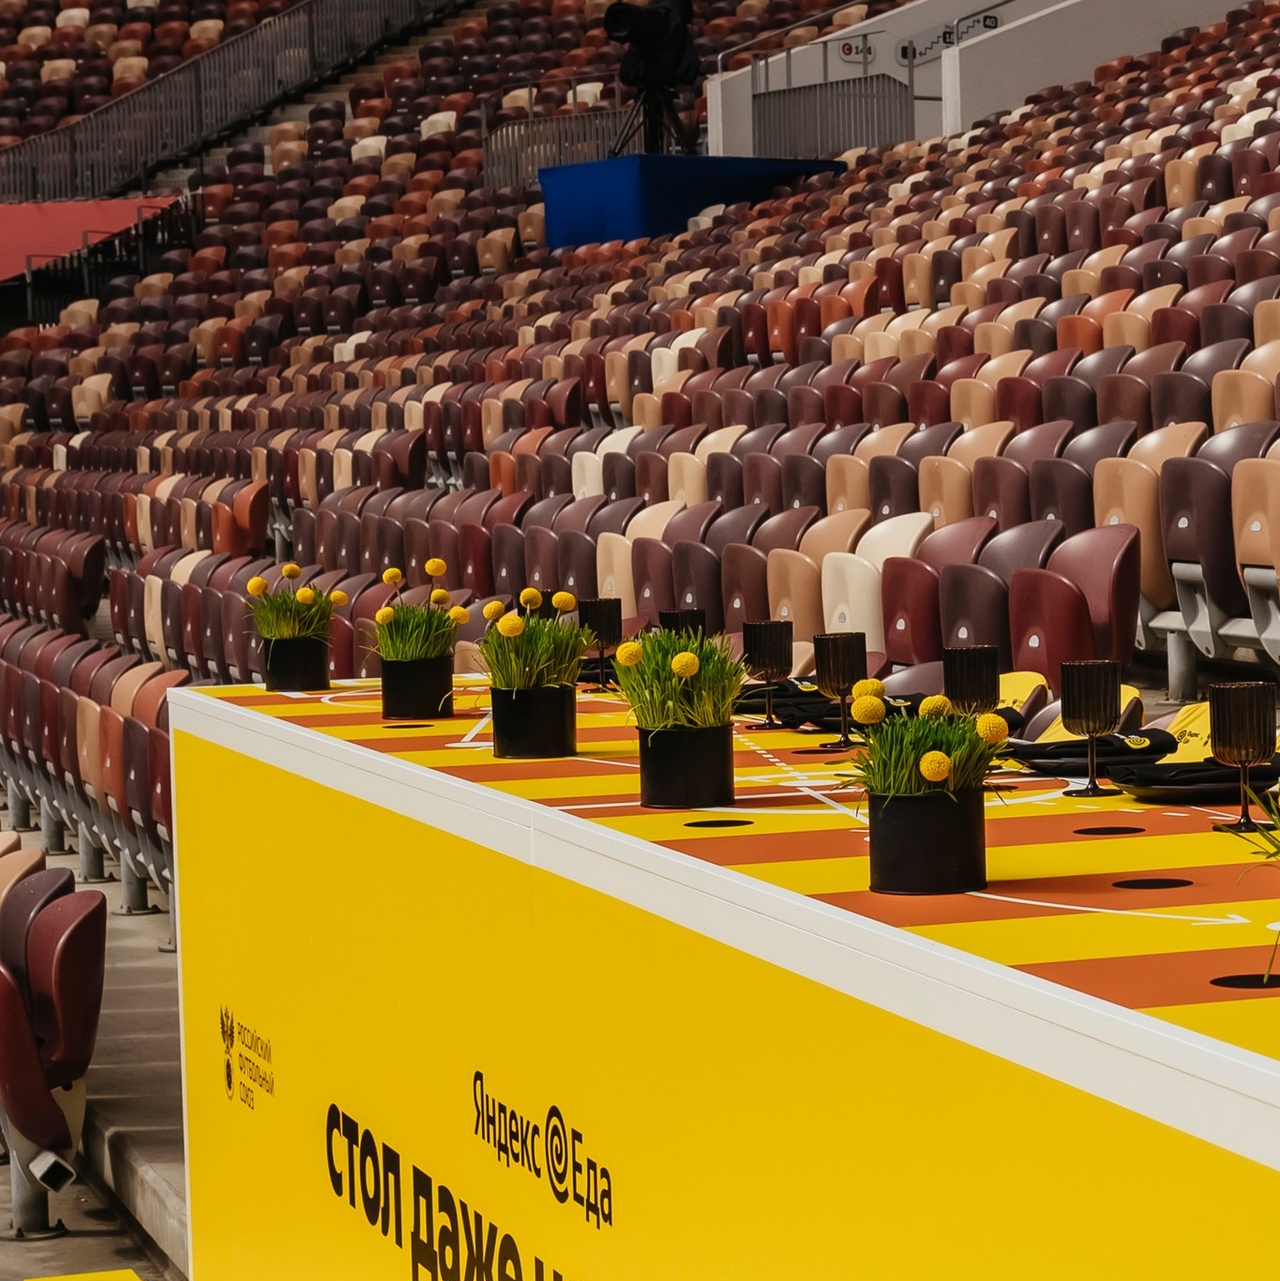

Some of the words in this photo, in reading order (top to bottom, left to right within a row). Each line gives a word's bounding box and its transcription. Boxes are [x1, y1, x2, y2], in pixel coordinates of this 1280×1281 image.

[238, 1051, 275, 1098] ФУТБОЛЬНЫЙ
[239, 1080, 255, 1111] СОЮЗ
[326, 1102, 404, 1250] стол
[473, 1069, 542, 1179] Яндекс
[570, 1126, 614, 1230] Еда
